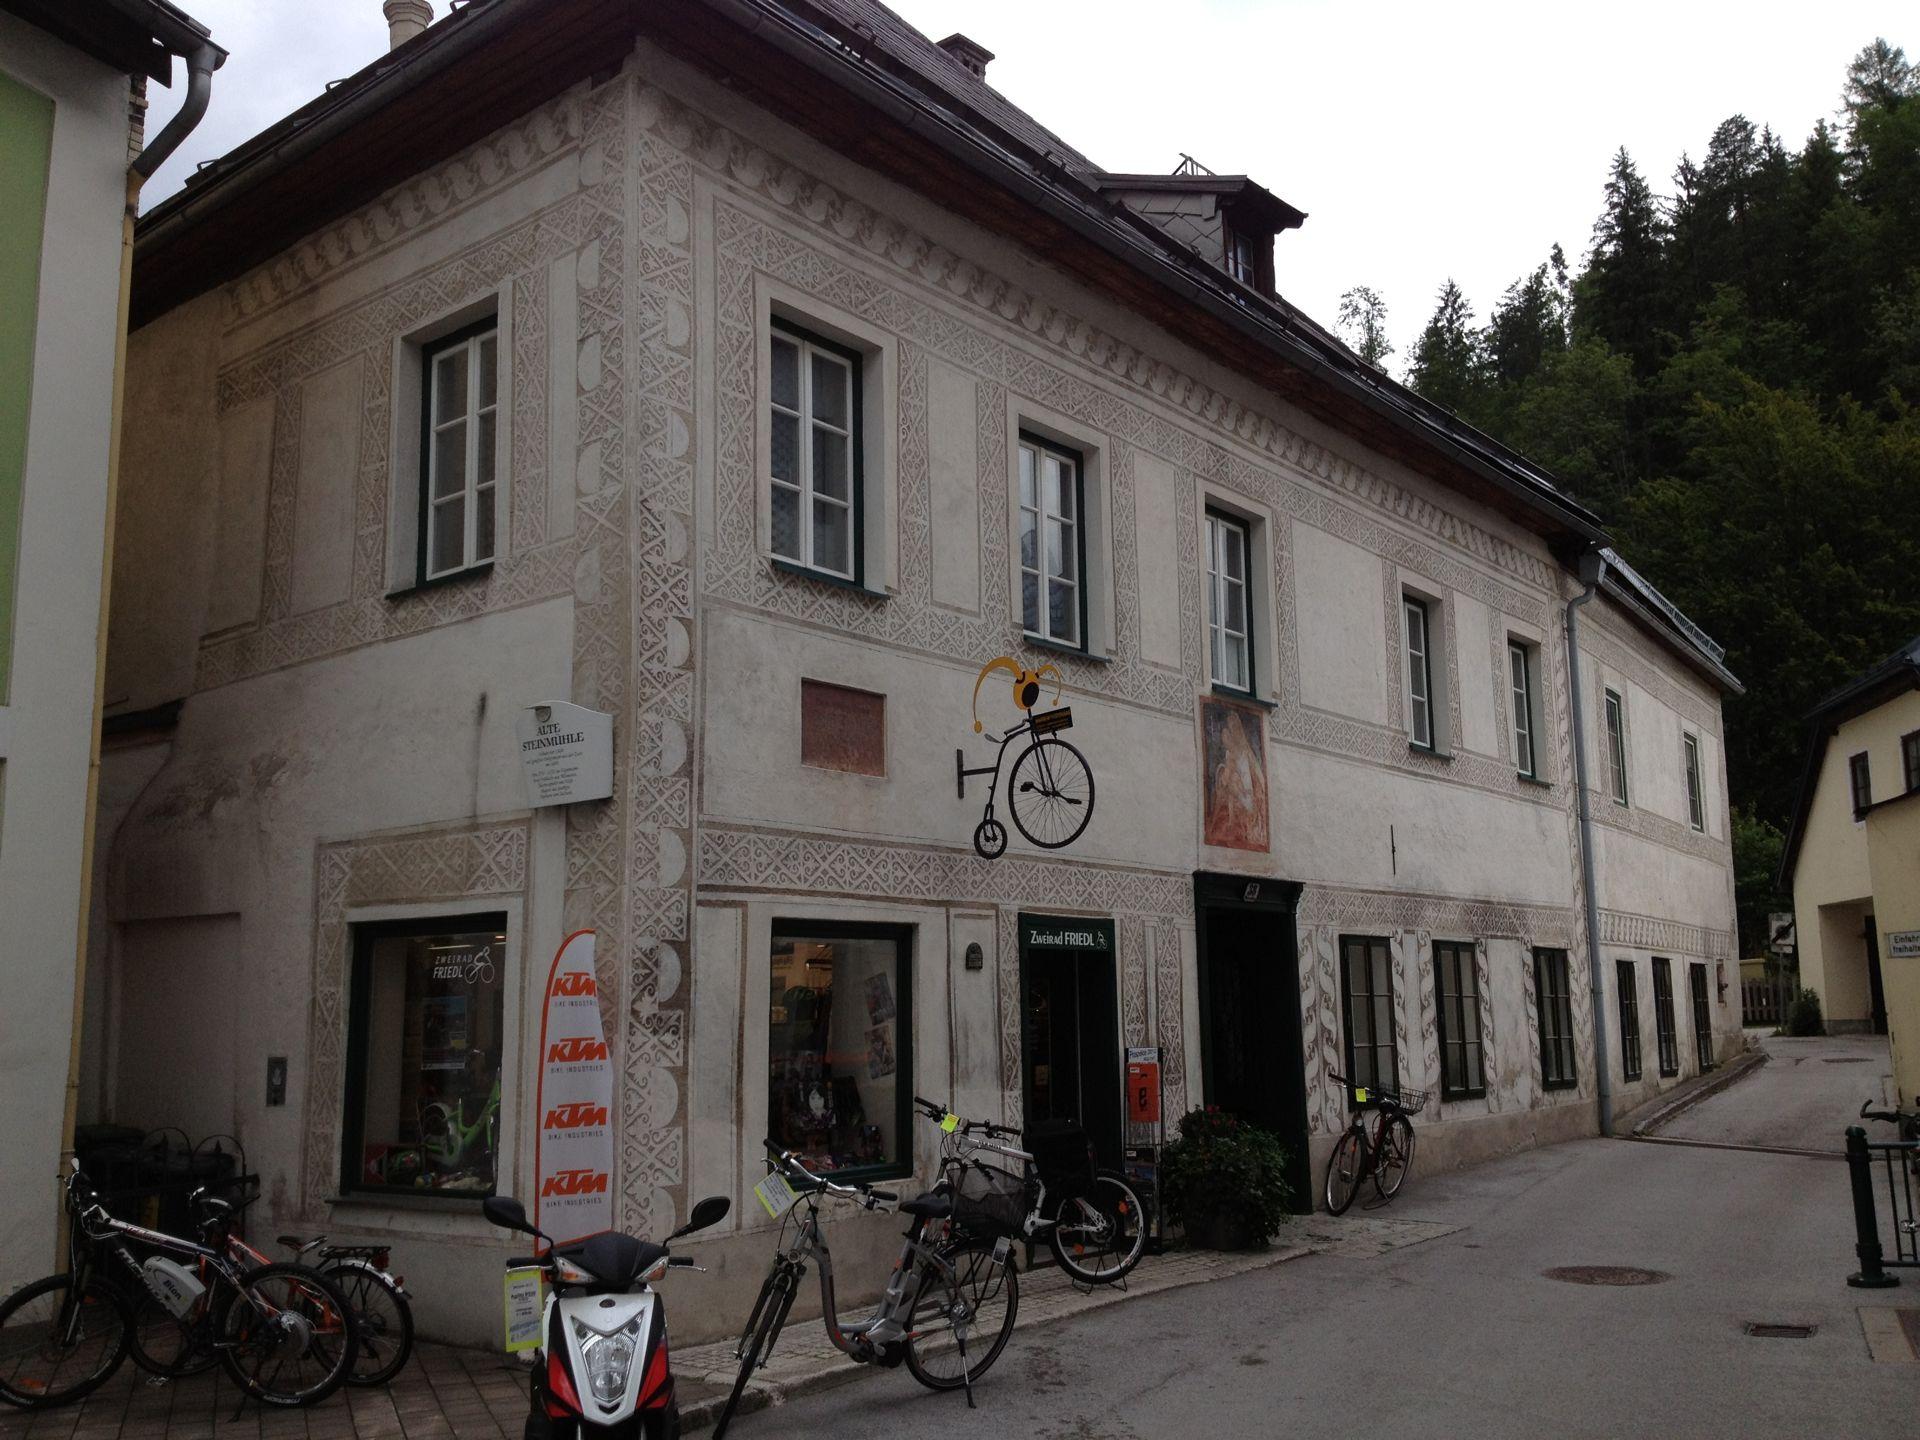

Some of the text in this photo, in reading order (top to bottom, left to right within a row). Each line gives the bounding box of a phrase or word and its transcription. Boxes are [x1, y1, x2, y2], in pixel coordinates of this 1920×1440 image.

[537, 724, 560, 736] ALTE
[1064, 931, 1095, 946] FRIEDL
[435, 955, 473, 965] ZWEIRAD
[433, 966, 463, 979] FRIEDL
[552, 972, 597, 996] KTM
[547, 1037, 608, 1063] KTM
[566, 1065, 604, 1073] INDUSTRIES
[544, 1102, 608, 1130] KTM
[564, 1131, 604, 1139] INDUSTRIES
[542, 1169, 608, 1197] KTM
[546, 1198, 602, 1208] BIKE INDUSTRIES
